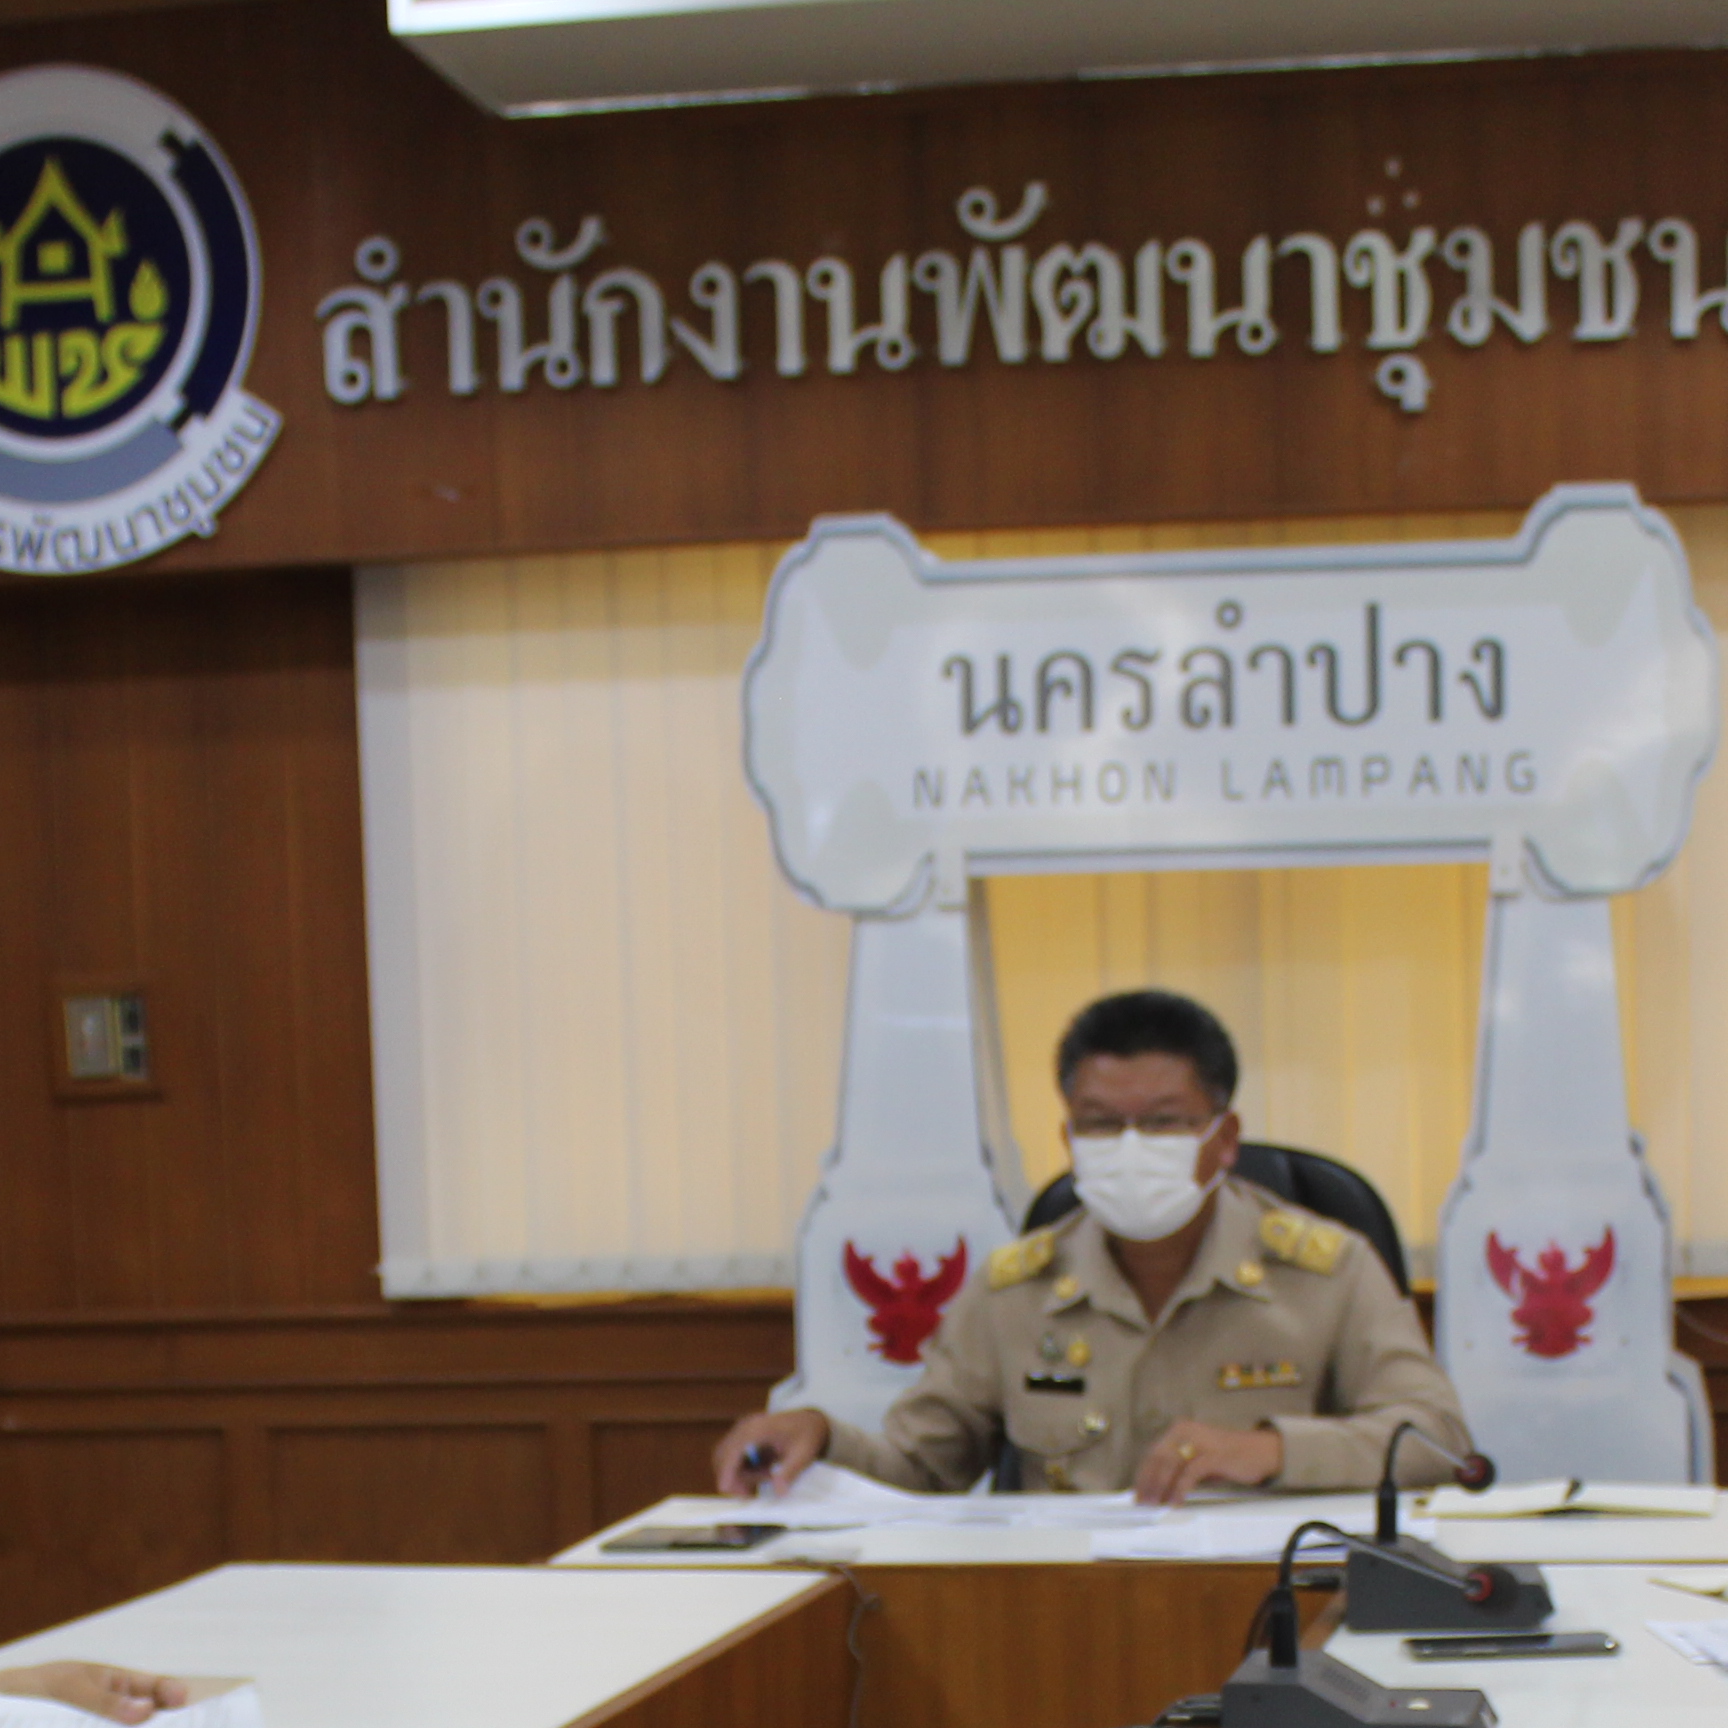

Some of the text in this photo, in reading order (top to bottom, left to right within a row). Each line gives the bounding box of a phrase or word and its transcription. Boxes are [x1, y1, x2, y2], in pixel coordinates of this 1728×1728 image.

[941, 598, 1509, 736] นครลำปาง
[912, 749, 1541, 810] NAKHON LAMPANG
